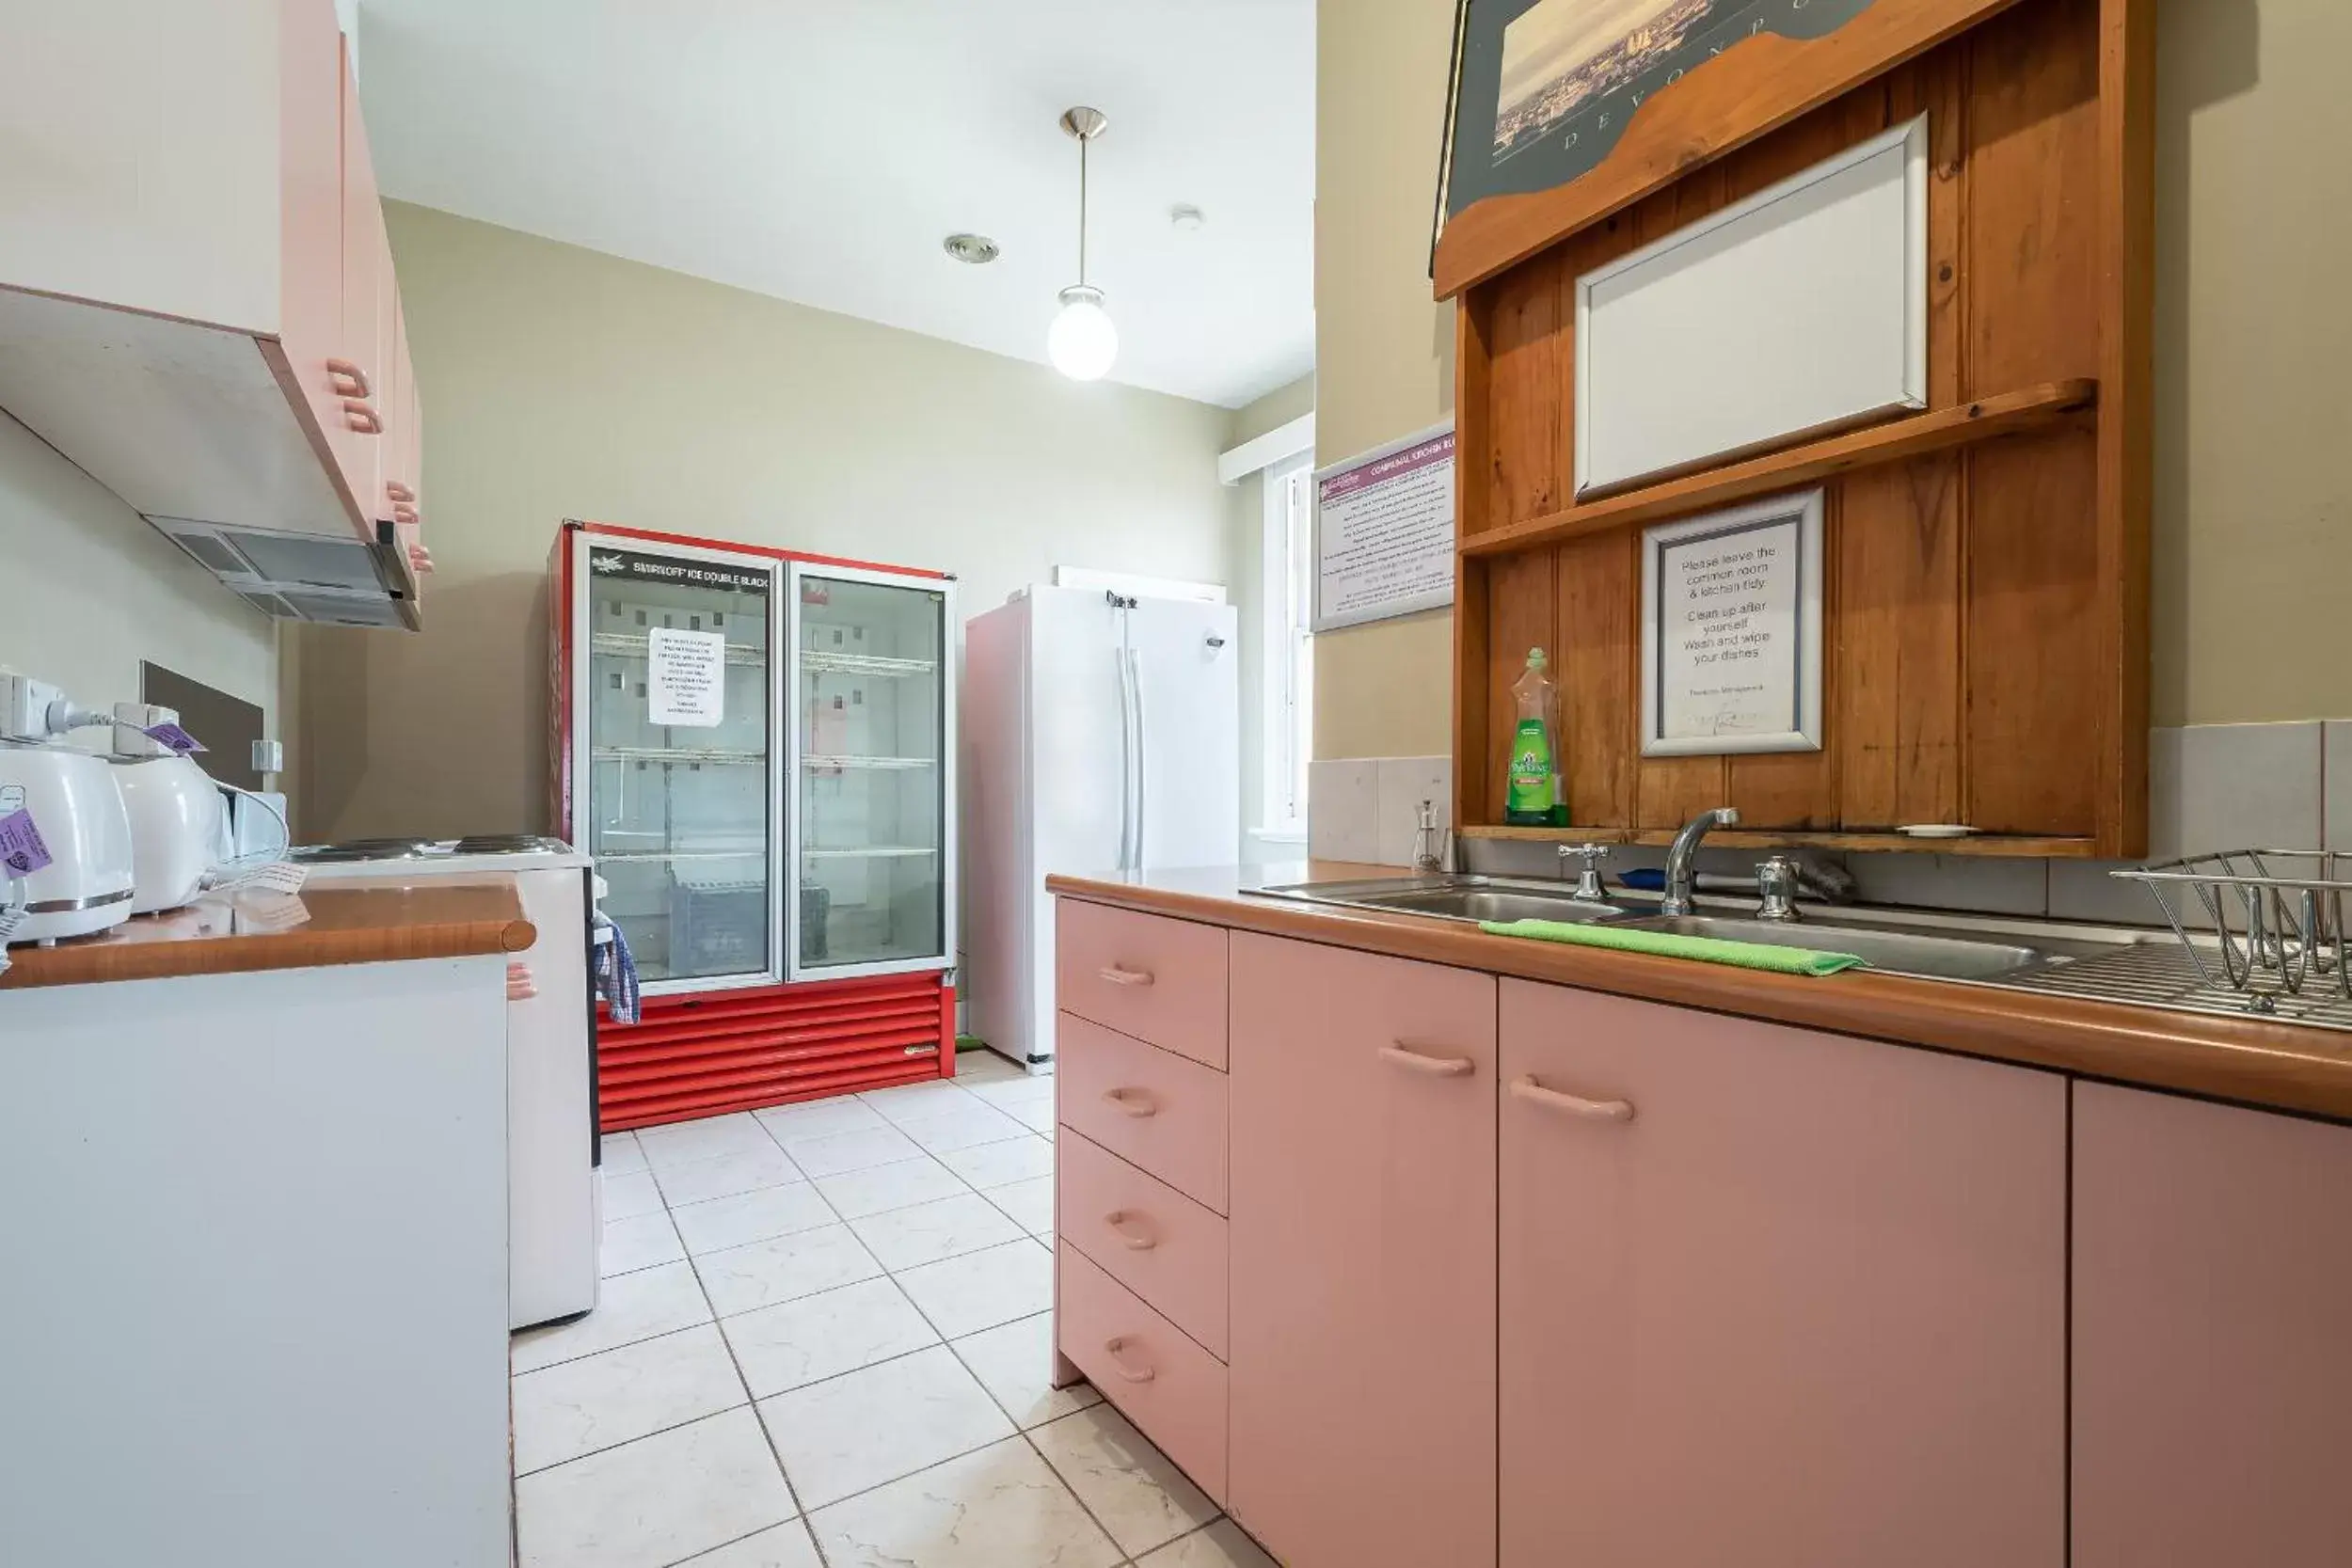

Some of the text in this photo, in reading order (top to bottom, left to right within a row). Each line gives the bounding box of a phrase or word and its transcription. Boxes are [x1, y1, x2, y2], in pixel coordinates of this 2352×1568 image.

[1682, 546, 1776, 571] Please leave the
[633, 562, 769, 588] SMIRNOFF ICE DOUBLE BLACK
[1686, 563, 1769, 585] common room
[1689, 578, 1766, 599] & kitchen tidy
[1687, 601, 1767, 622] Clean up after
[1703, 617, 1749, 636] yourself
[1683, 632, 1771, 651] Wash and wipe
[1694, 648, 1759, 666] your dishes
